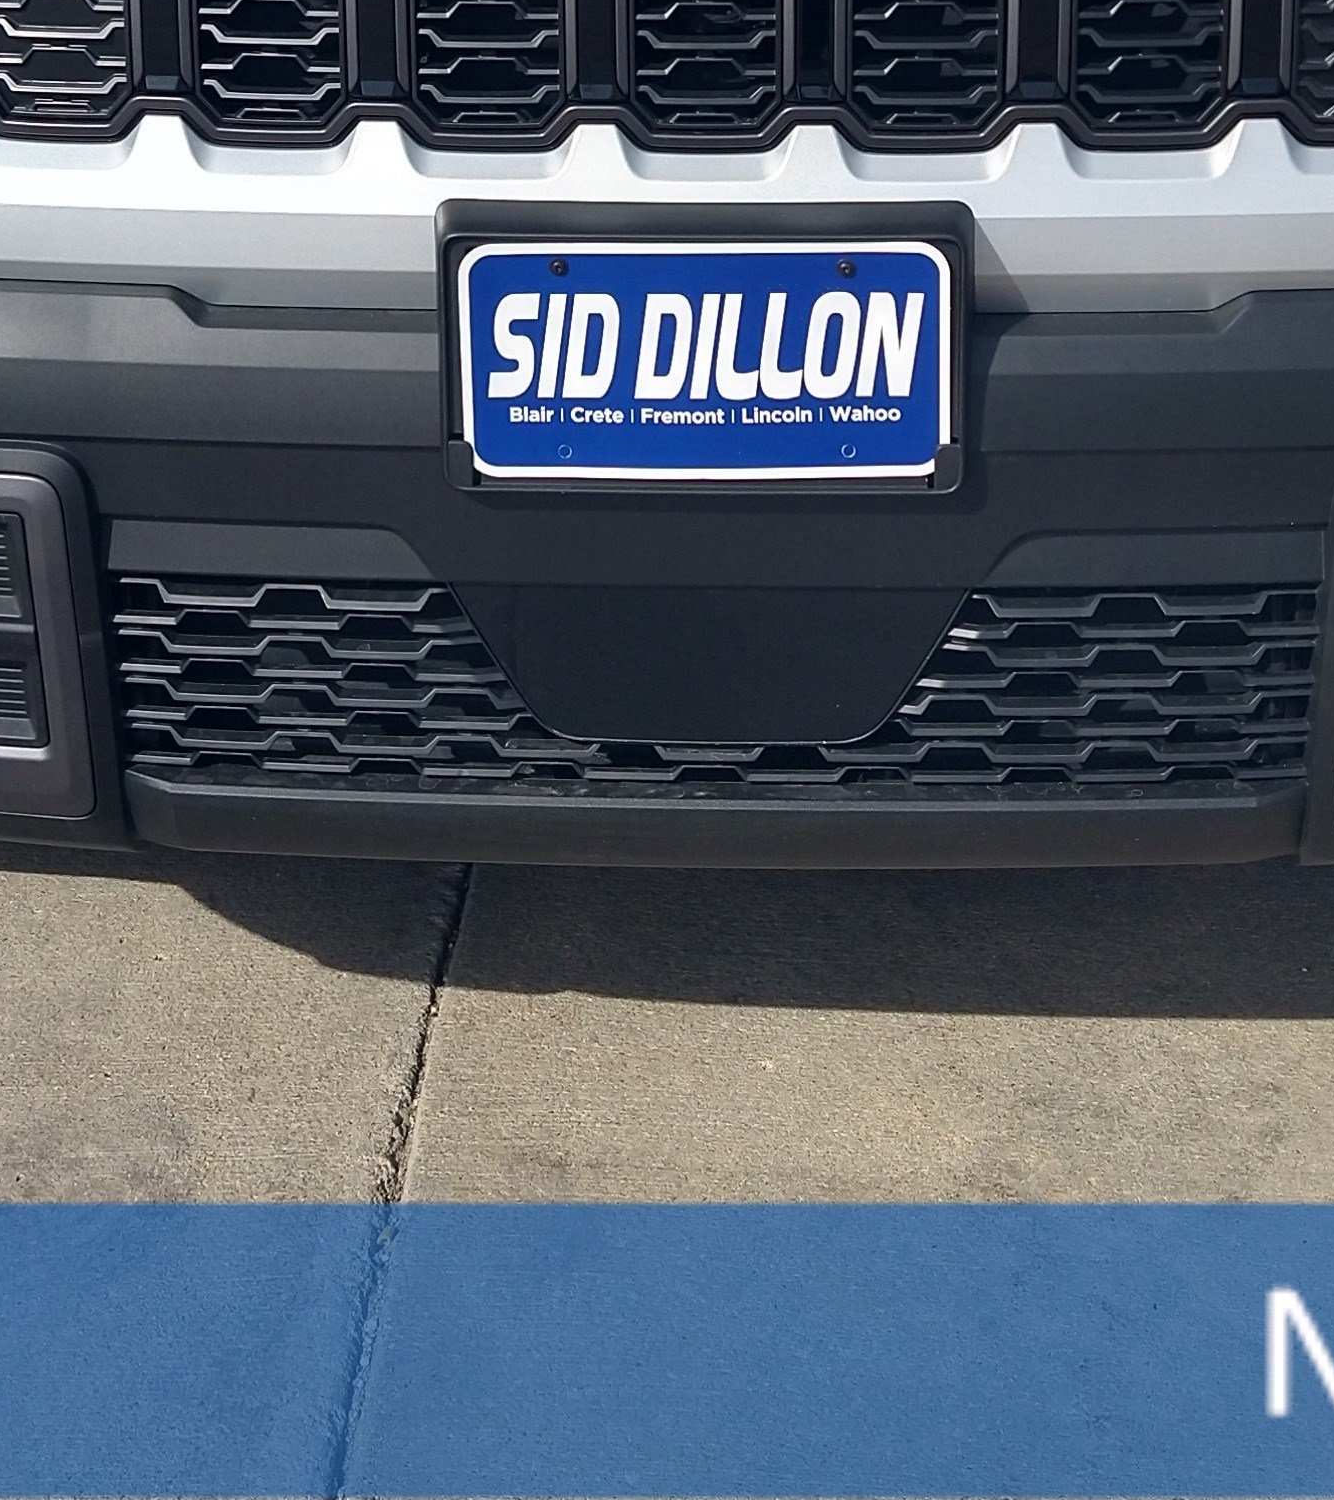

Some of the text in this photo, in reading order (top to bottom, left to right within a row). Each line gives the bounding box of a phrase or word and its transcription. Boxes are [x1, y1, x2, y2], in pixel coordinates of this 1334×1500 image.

[487, 290, 926, 402] SID DILLON
[509, 404, 902, 426] Blair Crete Fremont Lincoln Wahoo
